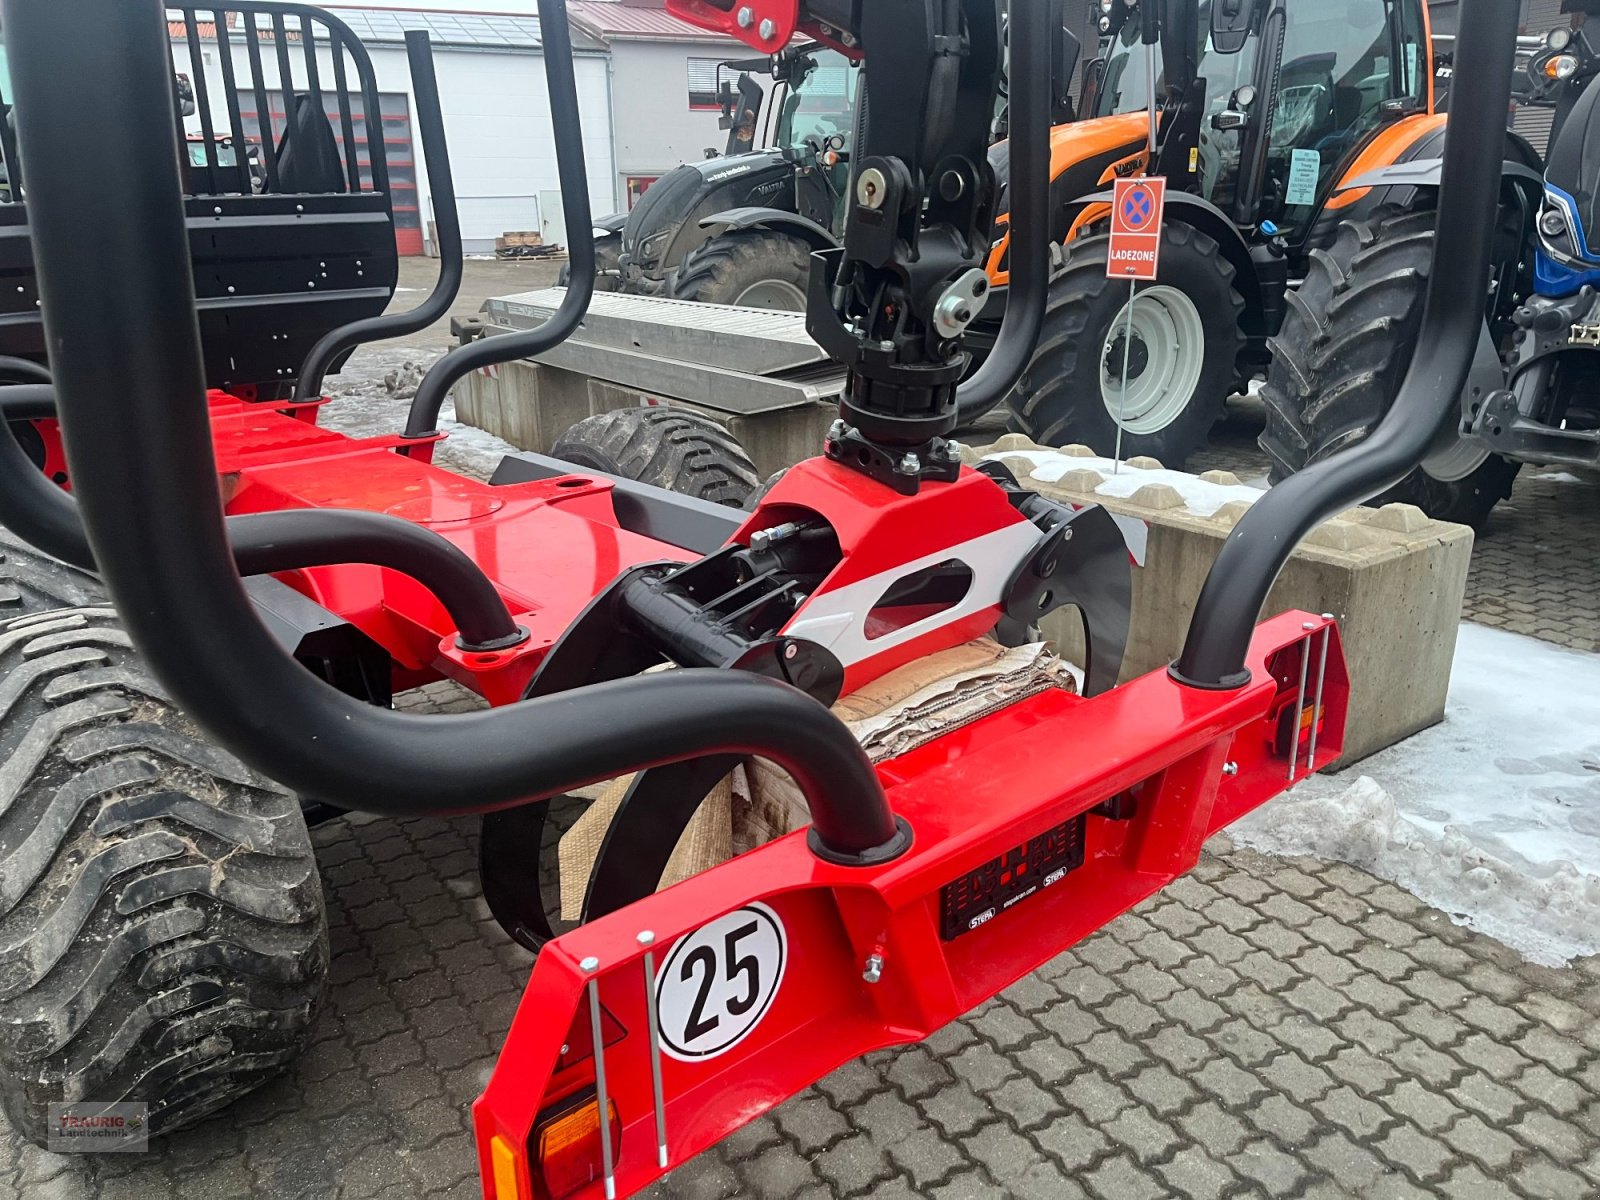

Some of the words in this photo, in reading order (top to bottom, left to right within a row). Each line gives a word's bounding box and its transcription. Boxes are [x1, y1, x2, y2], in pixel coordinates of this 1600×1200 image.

[758, 181, 785, 195] VALTRA
[1111, 249, 1155, 262] LADEZONE
[1044, 869, 1065, 887] STEPA
[970, 909, 993, 929] STEPA
[680, 919, 760, 1044] 25
